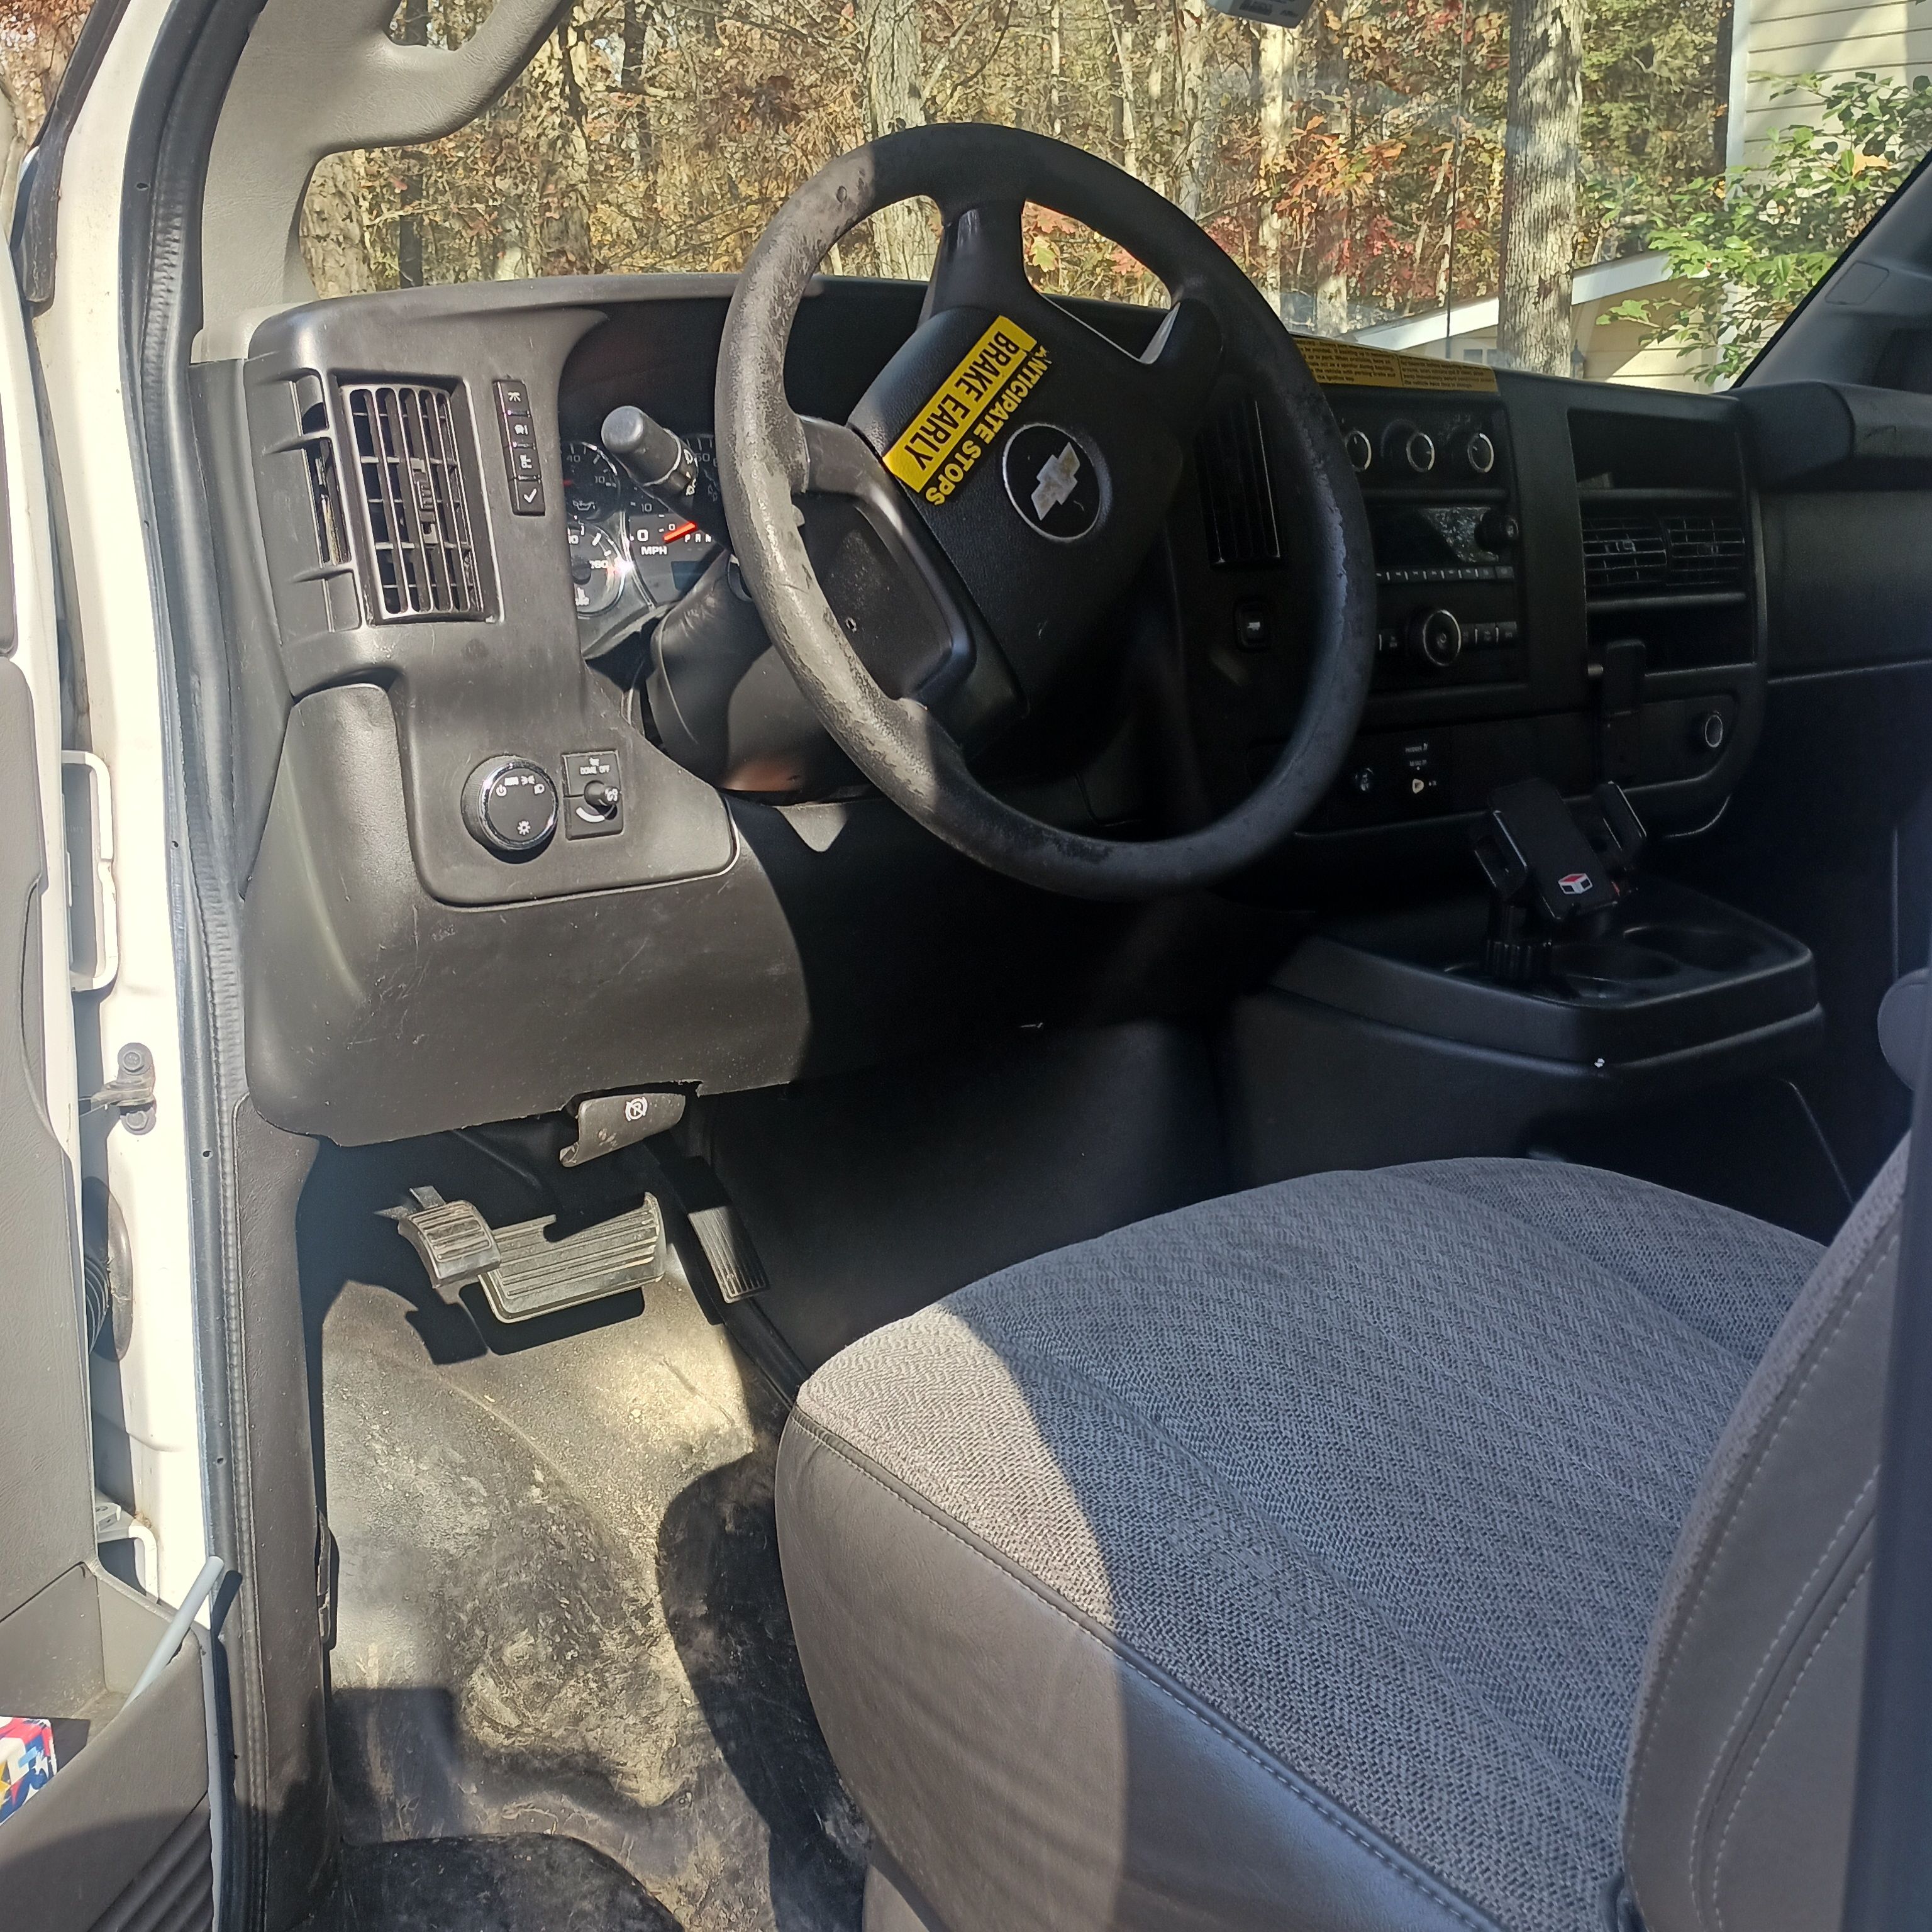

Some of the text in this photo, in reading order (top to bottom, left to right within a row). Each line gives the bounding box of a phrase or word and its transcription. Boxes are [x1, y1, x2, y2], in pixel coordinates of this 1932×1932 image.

[903, 331, 1020, 471] BRAKE EARLY
[925, 345, 1053, 506] ANTICIPATE STOPS
[641, 503, 652, 513] 10
[636, 529, 649, 541] 0
[640, 546, 668, 555] MPH
